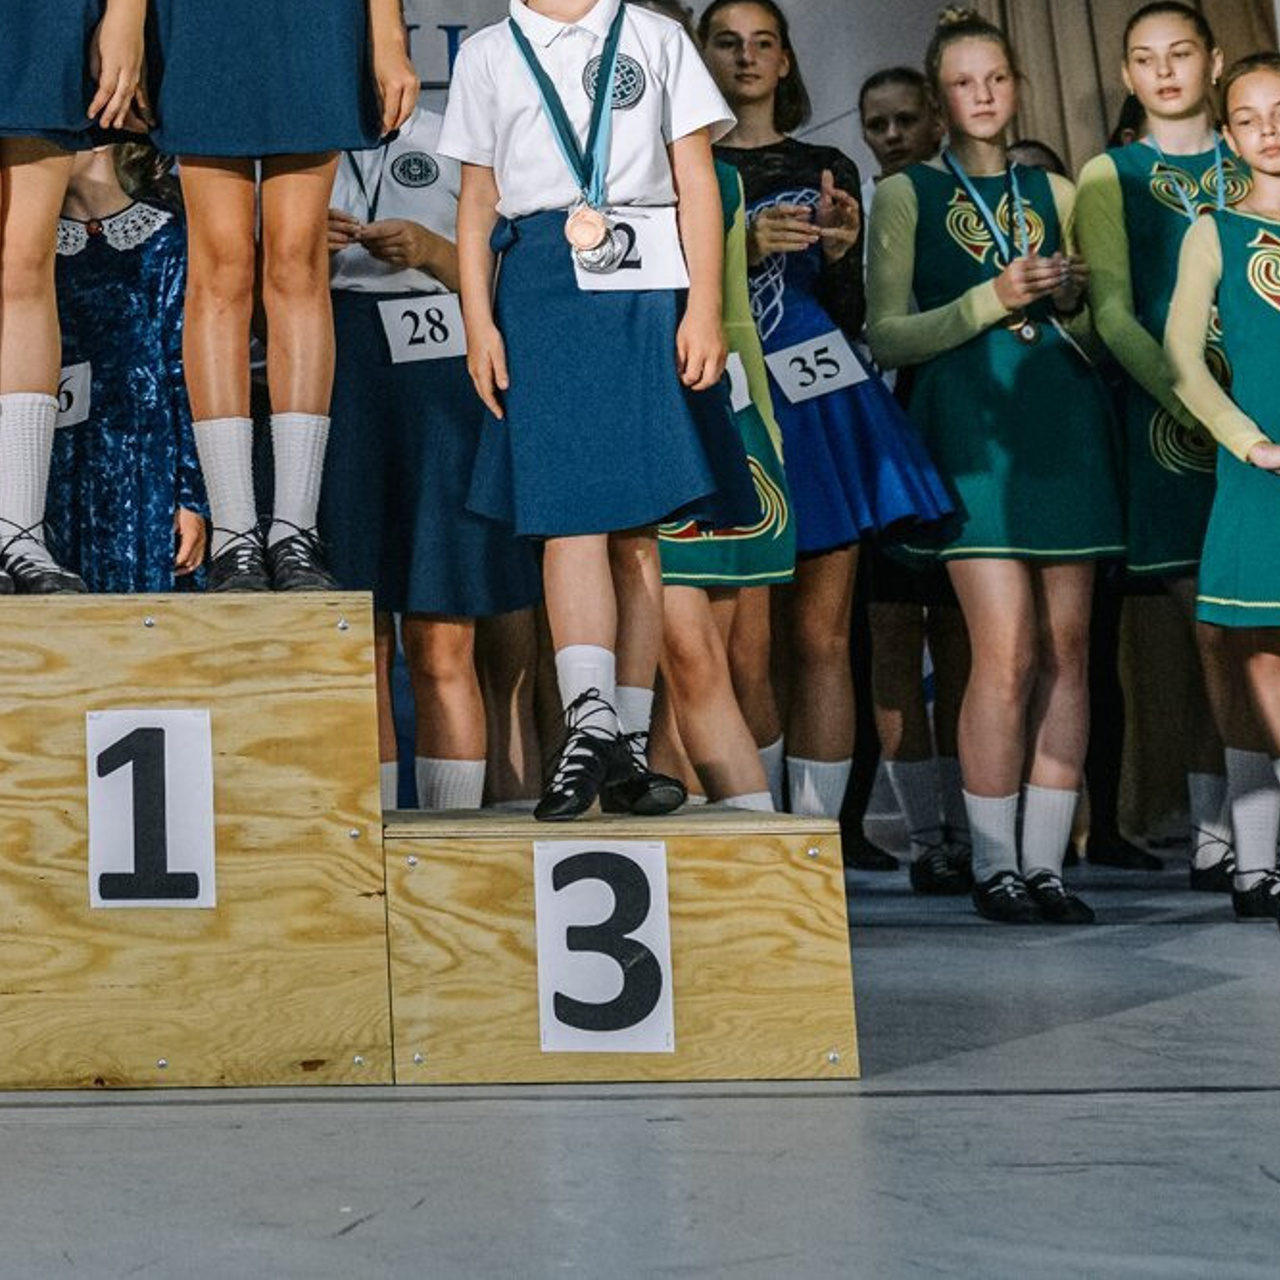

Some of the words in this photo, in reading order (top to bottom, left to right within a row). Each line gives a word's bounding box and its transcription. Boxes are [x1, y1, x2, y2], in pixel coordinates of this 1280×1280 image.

[401, 307, 449, 345] 28
[789, 346, 840, 387] 35
[96, 727, 200, 901] 1
[552, 851, 663, 1032] 3
